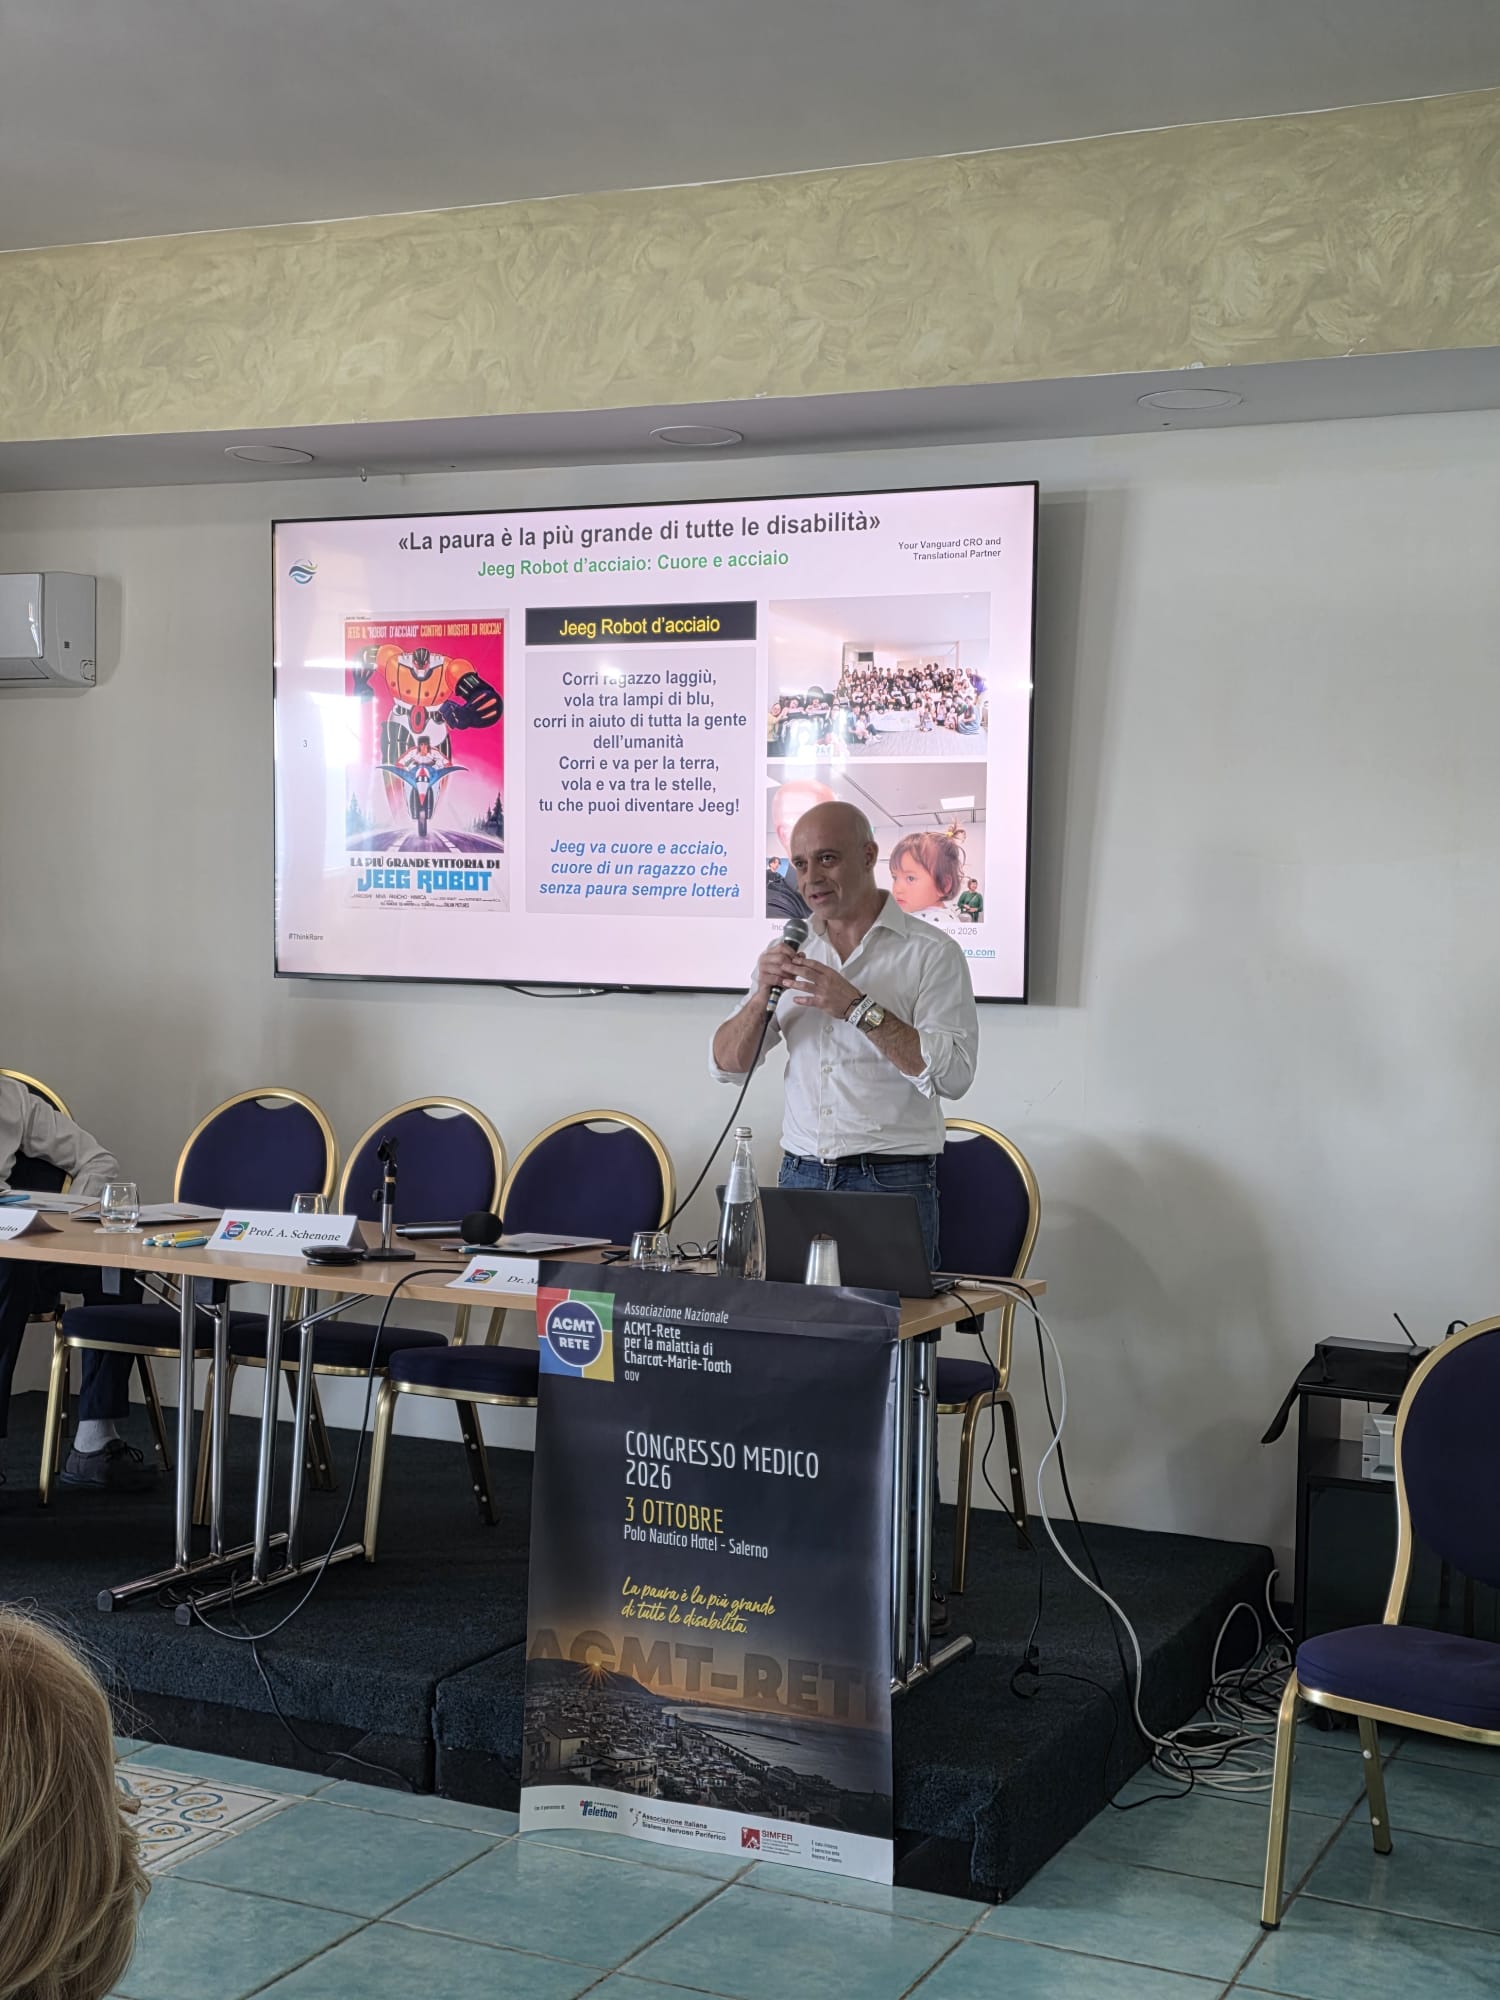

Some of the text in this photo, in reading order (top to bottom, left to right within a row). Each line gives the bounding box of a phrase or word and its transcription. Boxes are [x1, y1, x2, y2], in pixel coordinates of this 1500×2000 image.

[398, 511, 881, 554] «La paura è la più grande di tutte le disabilità»
[898, 537, 1001, 550] Your Vanguard CRO and
[913, 549, 1001, 560] Translational Partner
[478, 561, 515, 579] Jeeg
[520, 559, 569, 576] Robot
[657, 554, 708, 570] Cuore
[713, 555, 723, 568] e
[728, 550, 789, 567] acciaio
[559, 616, 720, 639] Jeeg Robot d’acciaio
[562, 669, 716, 688] Corri ragazzo laggiù,
[564, 691, 715, 709] vola tra lampi di blu,
[533, 713, 747, 730] corri in aiuto di tutta la gente
[559, 755, 719, 773] Corri e va per la terra,
[561, 777, 716, 793] vola e va tra le stelle,
[538, 798, 740, 816] tu che puoi diventare Jeeg!
[550, 840, 728, 857] Jeeg va cuore e acciaio,
[386, 857, 431, 869] GRANDE
[432, 858, 484, 870] VITTORIA
[486, 859, 500, 870] DI
[551, 861, 728, 879] cuore di un ragazzo che
[357, 869, 492, 893] JEEG ROBOT
[539, 882, 740, 900] senza paura sempre lotterà
[957, 927, 978, 936] 2026
[247, 1226, 274, 1237] Prof.
[276, 1229, 288, 1238] A.
[290, 1229, 342, 1242] Schenone
[506, 1275, 524, 1284] Dr.
[624, 1302, 729, 1324] Associazione Nazionale
[551, 1316, 596, 1333] ACMT
[624, 1321, 681, 1340] ACMT-Rete
[559, 1338, 590, 1351] RETE
[624, 1335, 713, 1357] per la malattia di
[624, 1350, 732, 1374] Charcot-Marie-Tooth
[624, 1370, 640, 1382] ODV
[625, 1430, 819, 1479] CONGRESSO MEDICO
[625, 1459, 671, 1490] 2026
[625, 1496, 724, 1534] 3 OTTOBRE
[624, 1524, 647, 1542] Polo
[649, 1528, 688, 1548] Nautico
[690, 1533, 718, 1552] Hotel
[729, 1538, 768, 1559] Salerno
[622, 1576, 776, 1617] La paura è la più grande
[621, 1599, 636, 1619] di
[637, 1602, 668, 1622] tutte
[668, 1604, 681, 1624] le
[580, 1800, 618, 1819] Telethon
[642, 1813, 708, 1830] Associazione Italiana
[642, 1821, 727, 1841] Sistema Nervoso Periferico
[761, 1830, 793, 1842] SIMFER
